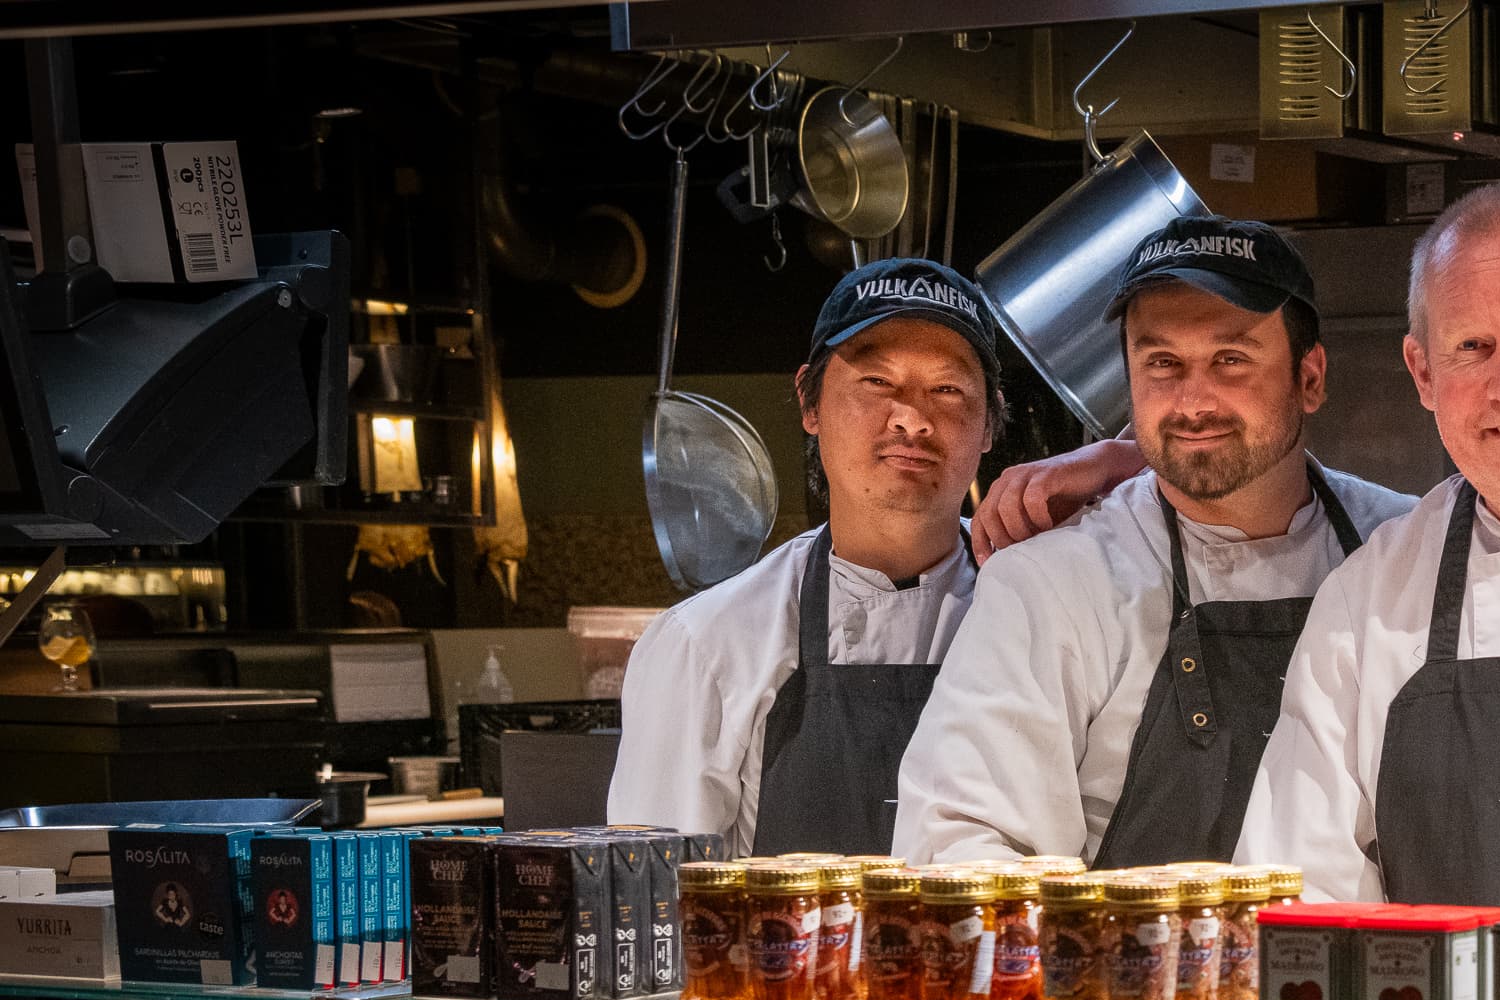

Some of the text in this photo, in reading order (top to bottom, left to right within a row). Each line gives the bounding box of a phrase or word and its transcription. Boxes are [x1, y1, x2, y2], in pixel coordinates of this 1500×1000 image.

[208, 156, 231, 264] NITRILE GLOVE POWDER FREE
[216, 156, 243, 244] 220253L
[1137, 236, 1257, 264] VULKANFISK
[855, 275, 980, 320] VULKANFISK
[125, 846, 191, 869] ROSALITA
[260, 852, 302, 868] ROSALITA
[17, 918, 71, 936] YURRITA
